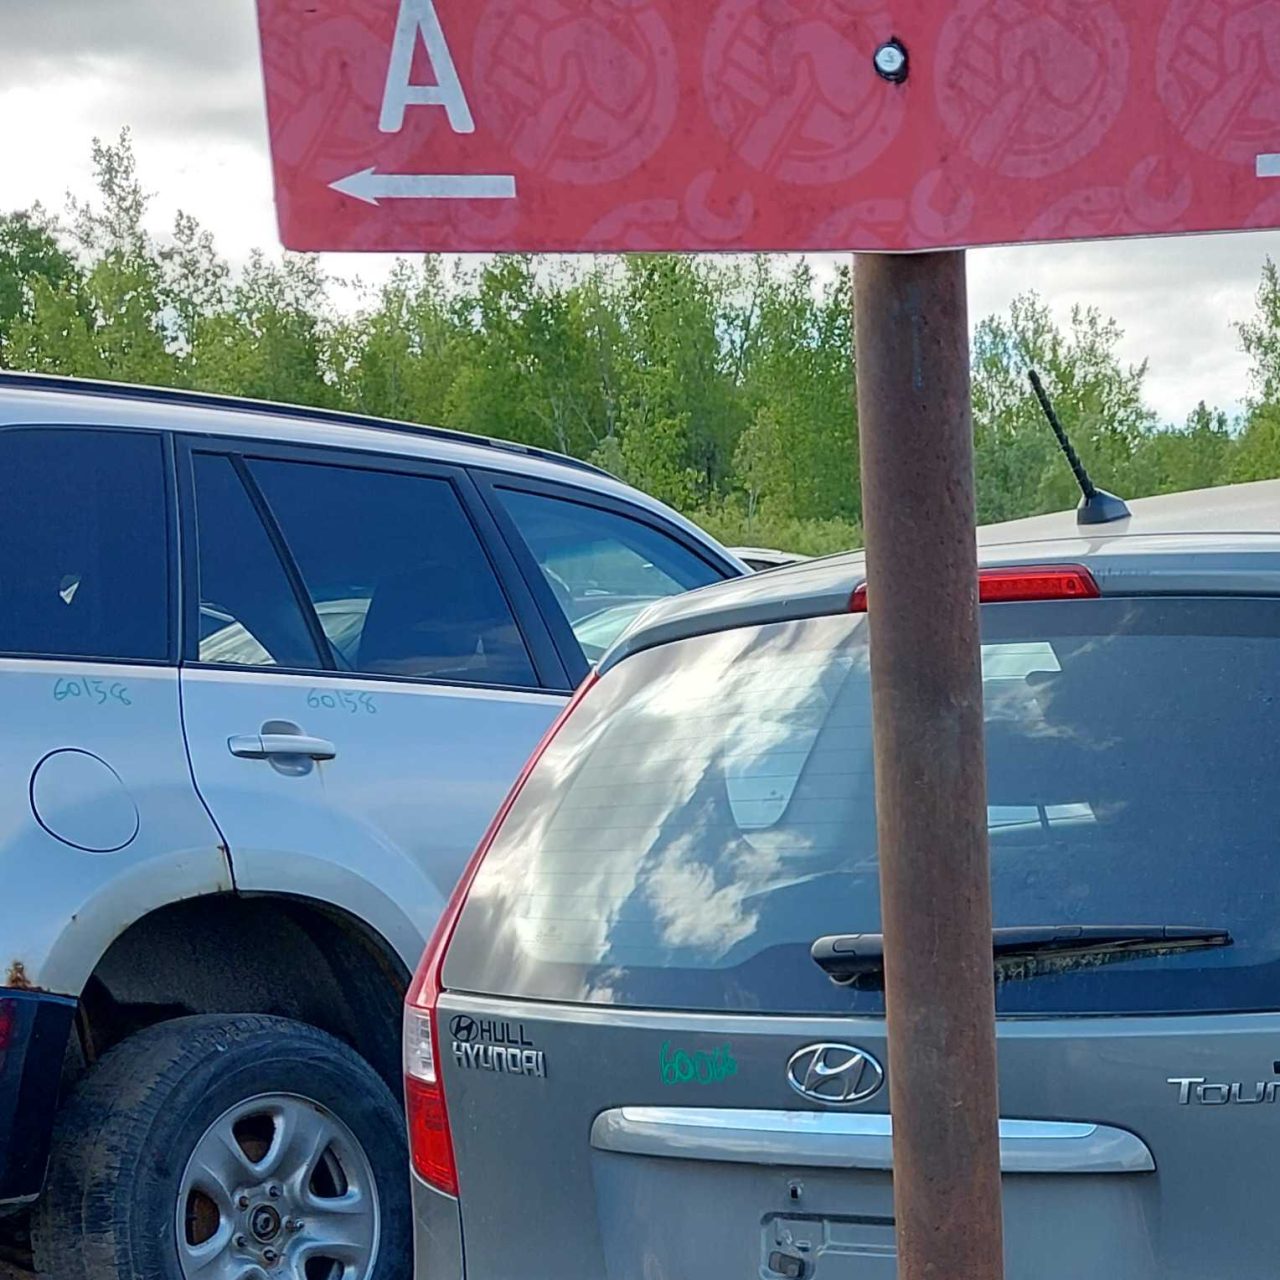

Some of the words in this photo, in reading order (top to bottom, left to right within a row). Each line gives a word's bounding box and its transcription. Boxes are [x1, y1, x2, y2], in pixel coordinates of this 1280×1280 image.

[378, 0, 475, 133] A
[52, 677, 132, 706] 60158
[479, 1020, 533, 1046] HULL
[452, 1042, 547, 1077] HYUNDAI
